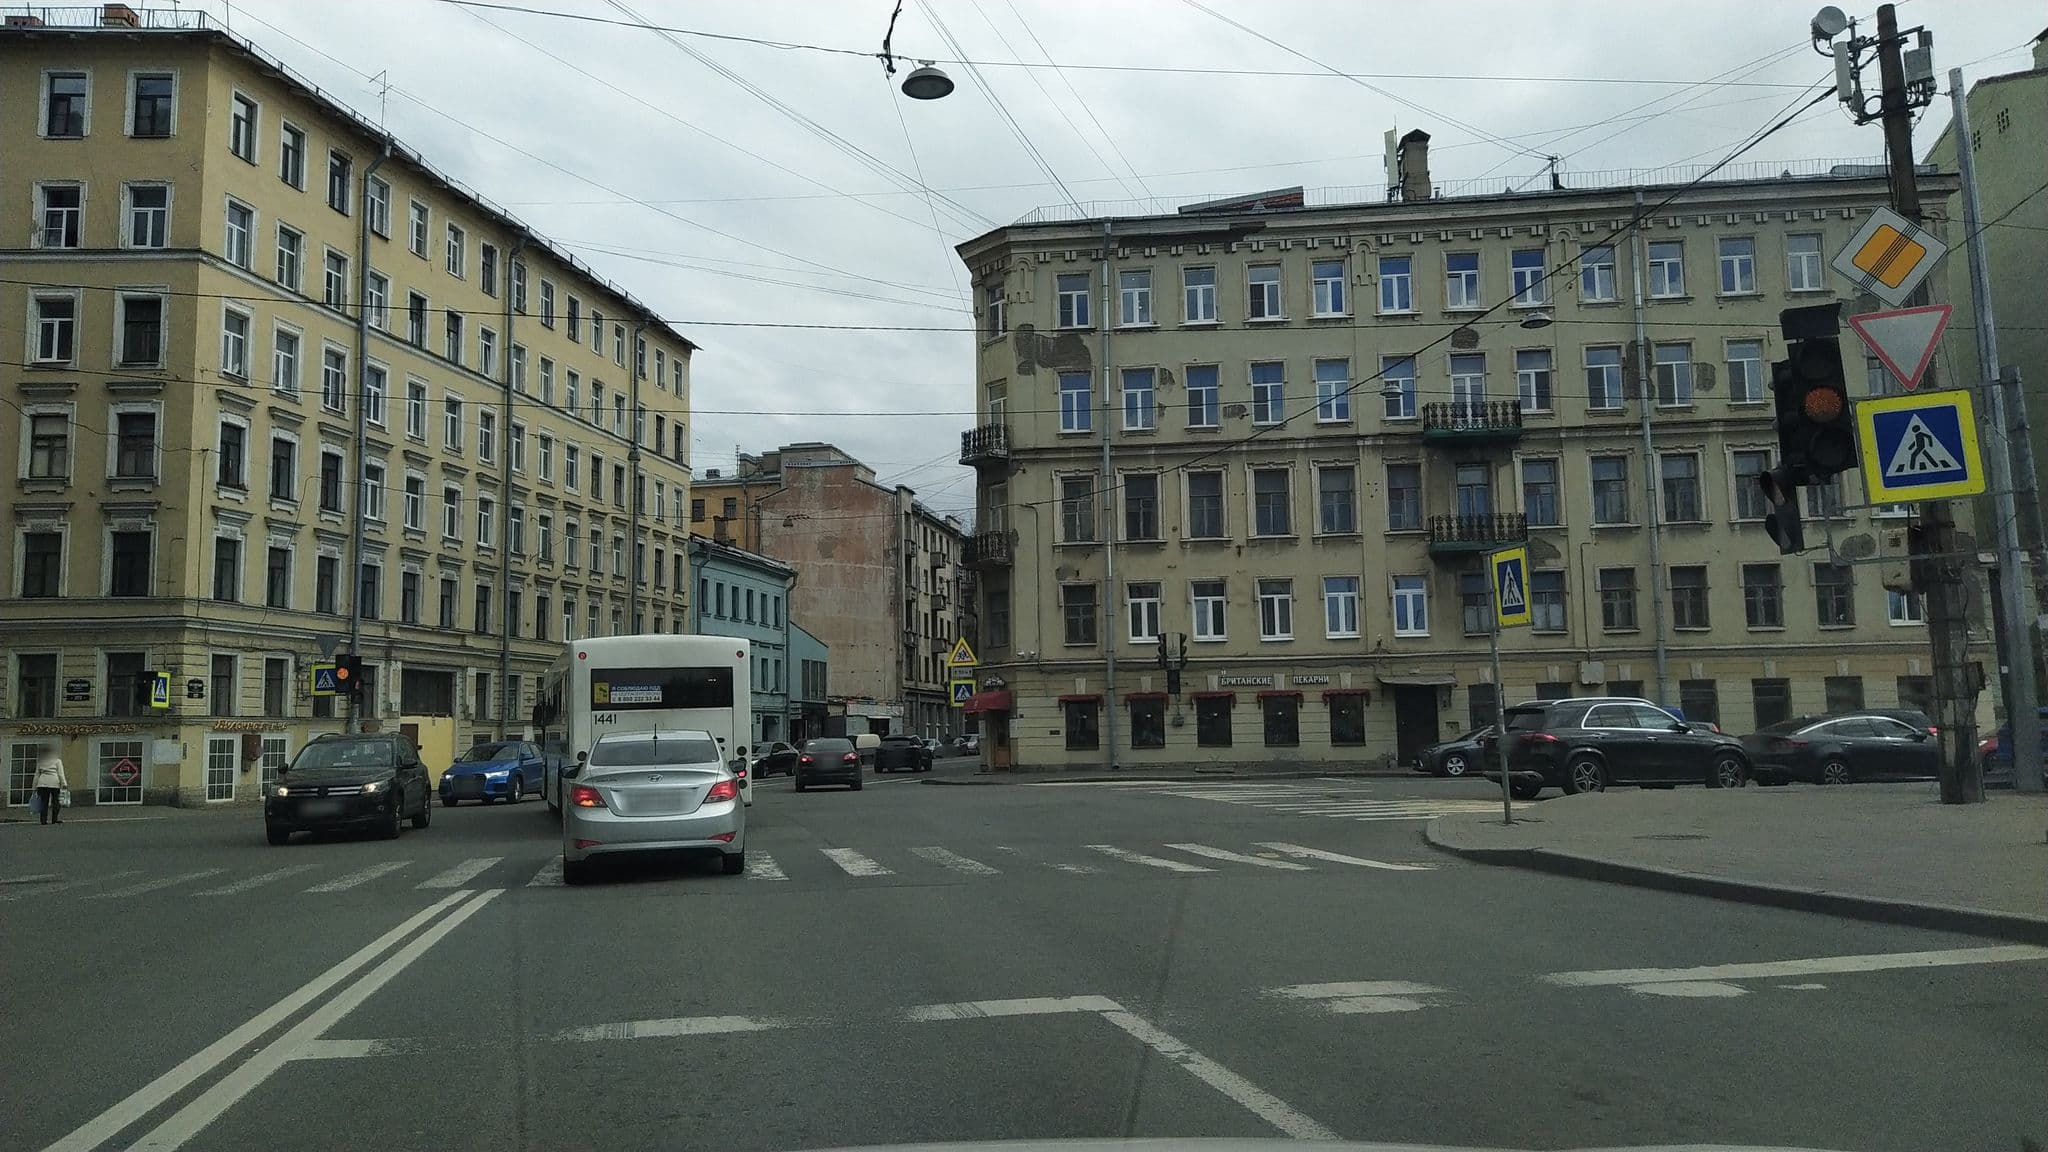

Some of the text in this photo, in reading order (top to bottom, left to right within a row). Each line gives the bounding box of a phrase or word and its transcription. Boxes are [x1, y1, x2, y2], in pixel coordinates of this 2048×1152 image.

[1221, 675, 1329, 686] БРИТАНСКИЕ ПЕКАРНИ
[594, 713, 617, 725] 1441
